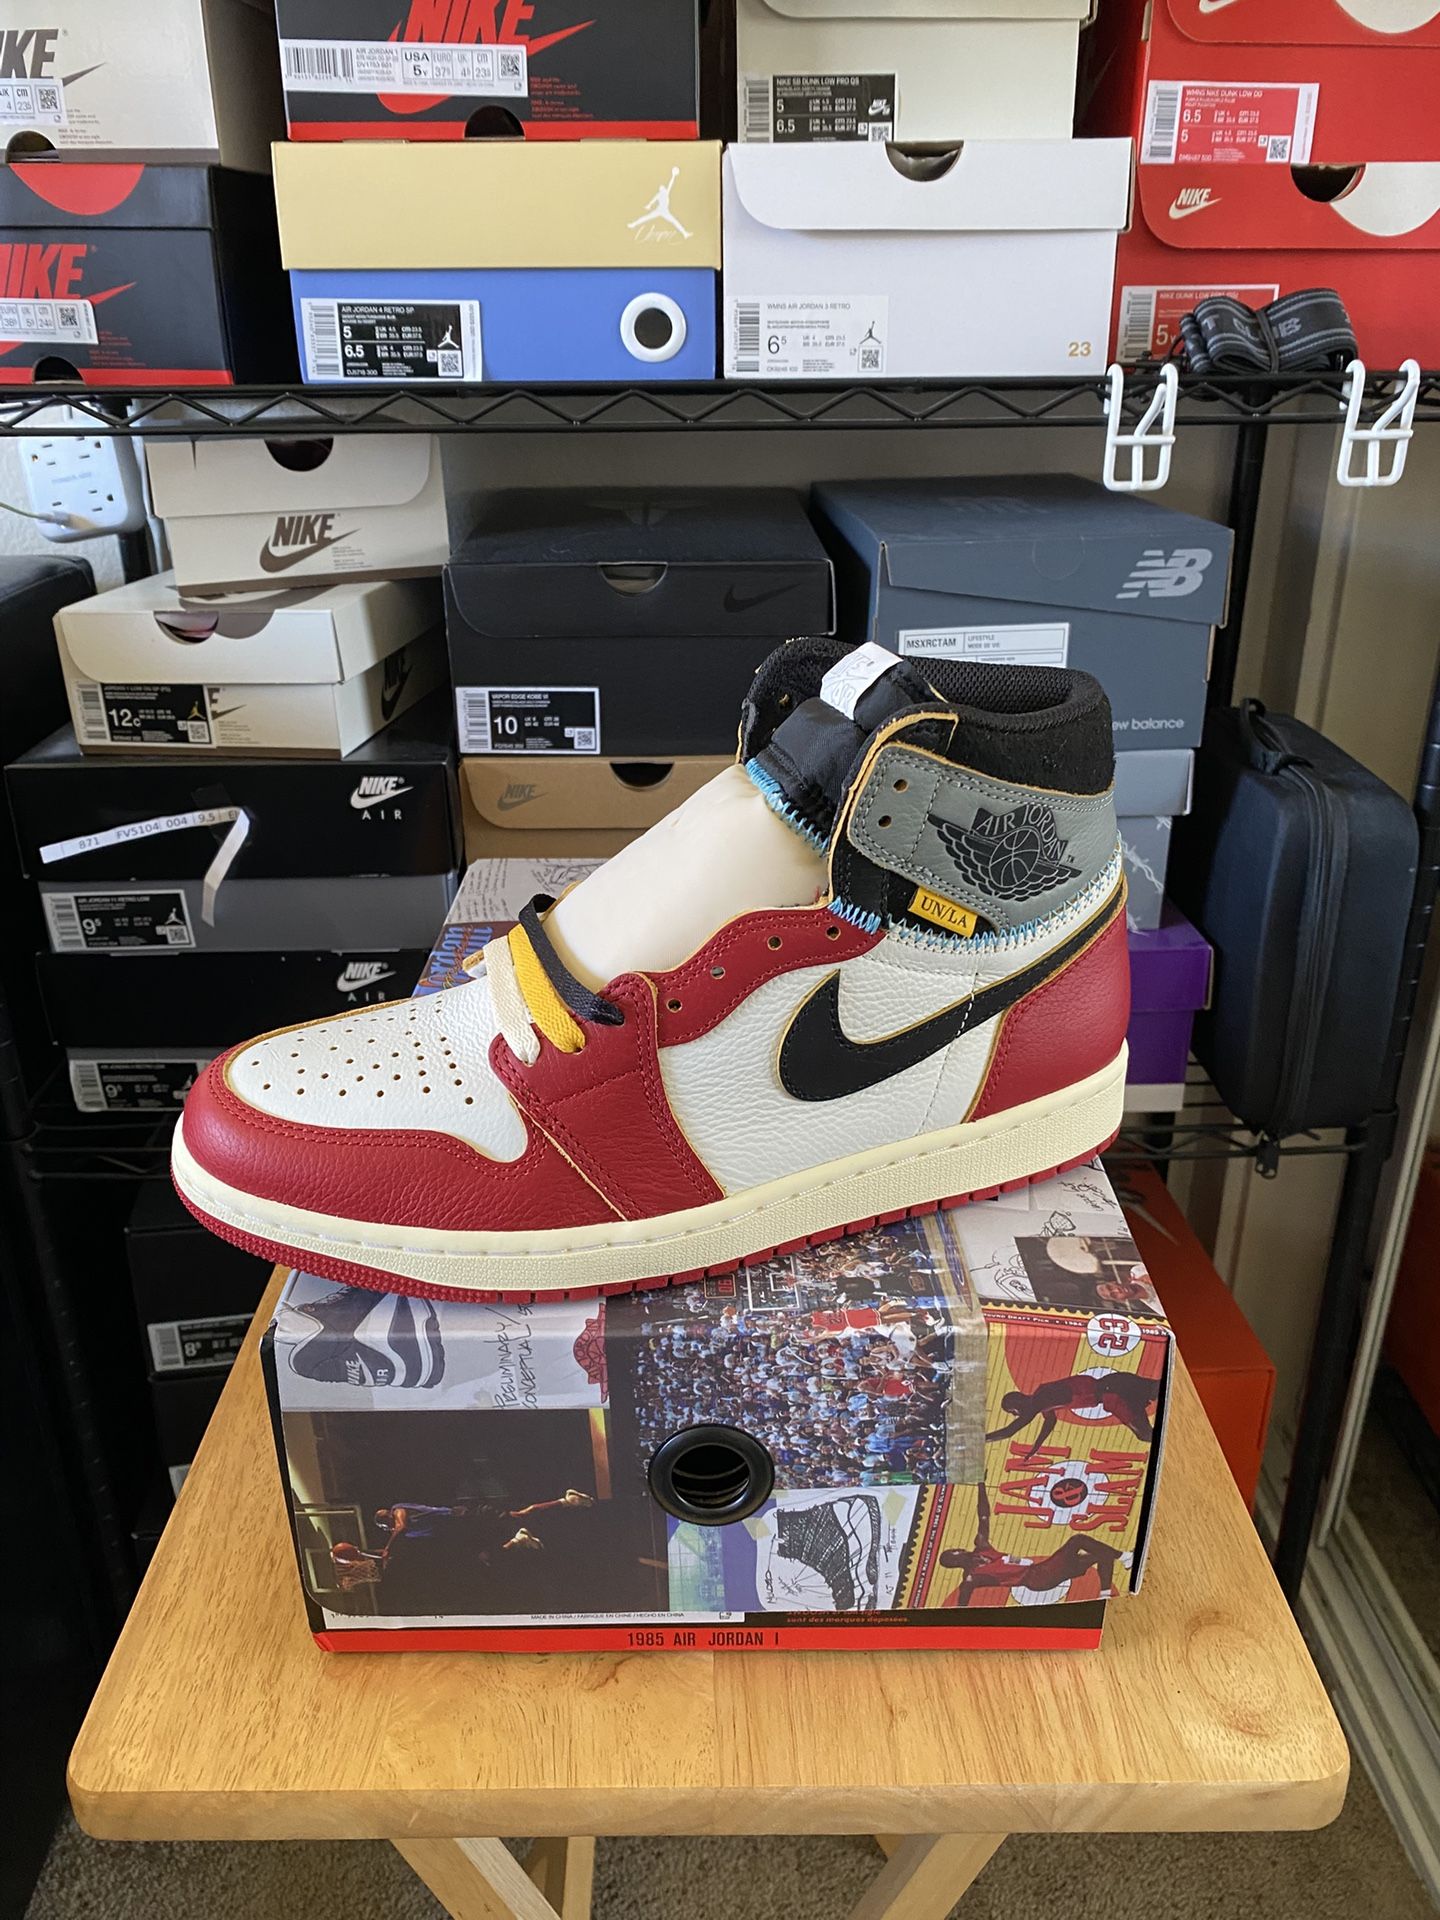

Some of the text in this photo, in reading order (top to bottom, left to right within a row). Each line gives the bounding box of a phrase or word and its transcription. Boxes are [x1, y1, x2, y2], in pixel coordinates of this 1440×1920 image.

[0, 28, 59, 78] KE
[404, 52, 429, 62] USA
[776, 98, 784, 113] 5
[1183, 109, 1201, 123] 6.5
[776, 118, 795, 133] 6.5
[1177, 188, 1211, 206] NIKE
[343, 326, 352, 339] 5
[344, 345, 364, 358] 6.5
[1068, 342, 1091, 357] 23
[272, 513, 336, 547] NIKE
[1115, 548, 1213, 599] NB
[906, 638, 957, 649] MSXRCTAM
[494, 716, 518, 735] 10
[1112, 717, 1185, 731] ew balance
[358, 777, 399, 795] NIKE
[505, 784, 536, 799] NIKE
[361, 809, 403, 820] AIR
[79, 812, 216, 850] 871 FV5104 004 9.5
[976, 811, 1023, 837] AIR
[1020, 804, 1067, 861] JORDAN
[920, 896, 969, 930] UN/LA
[345, 962, 382, 979] NIKE
[348, 992, 385, 1002] AIR
[1099, 1317, 1130, 1350] 23
[994, 1441, 1071, 1529] JAM
[1069, 1448, 1149, 1532] SLAM
[628, 1631, 780, 1647] 1985 AIR JORDAN I
